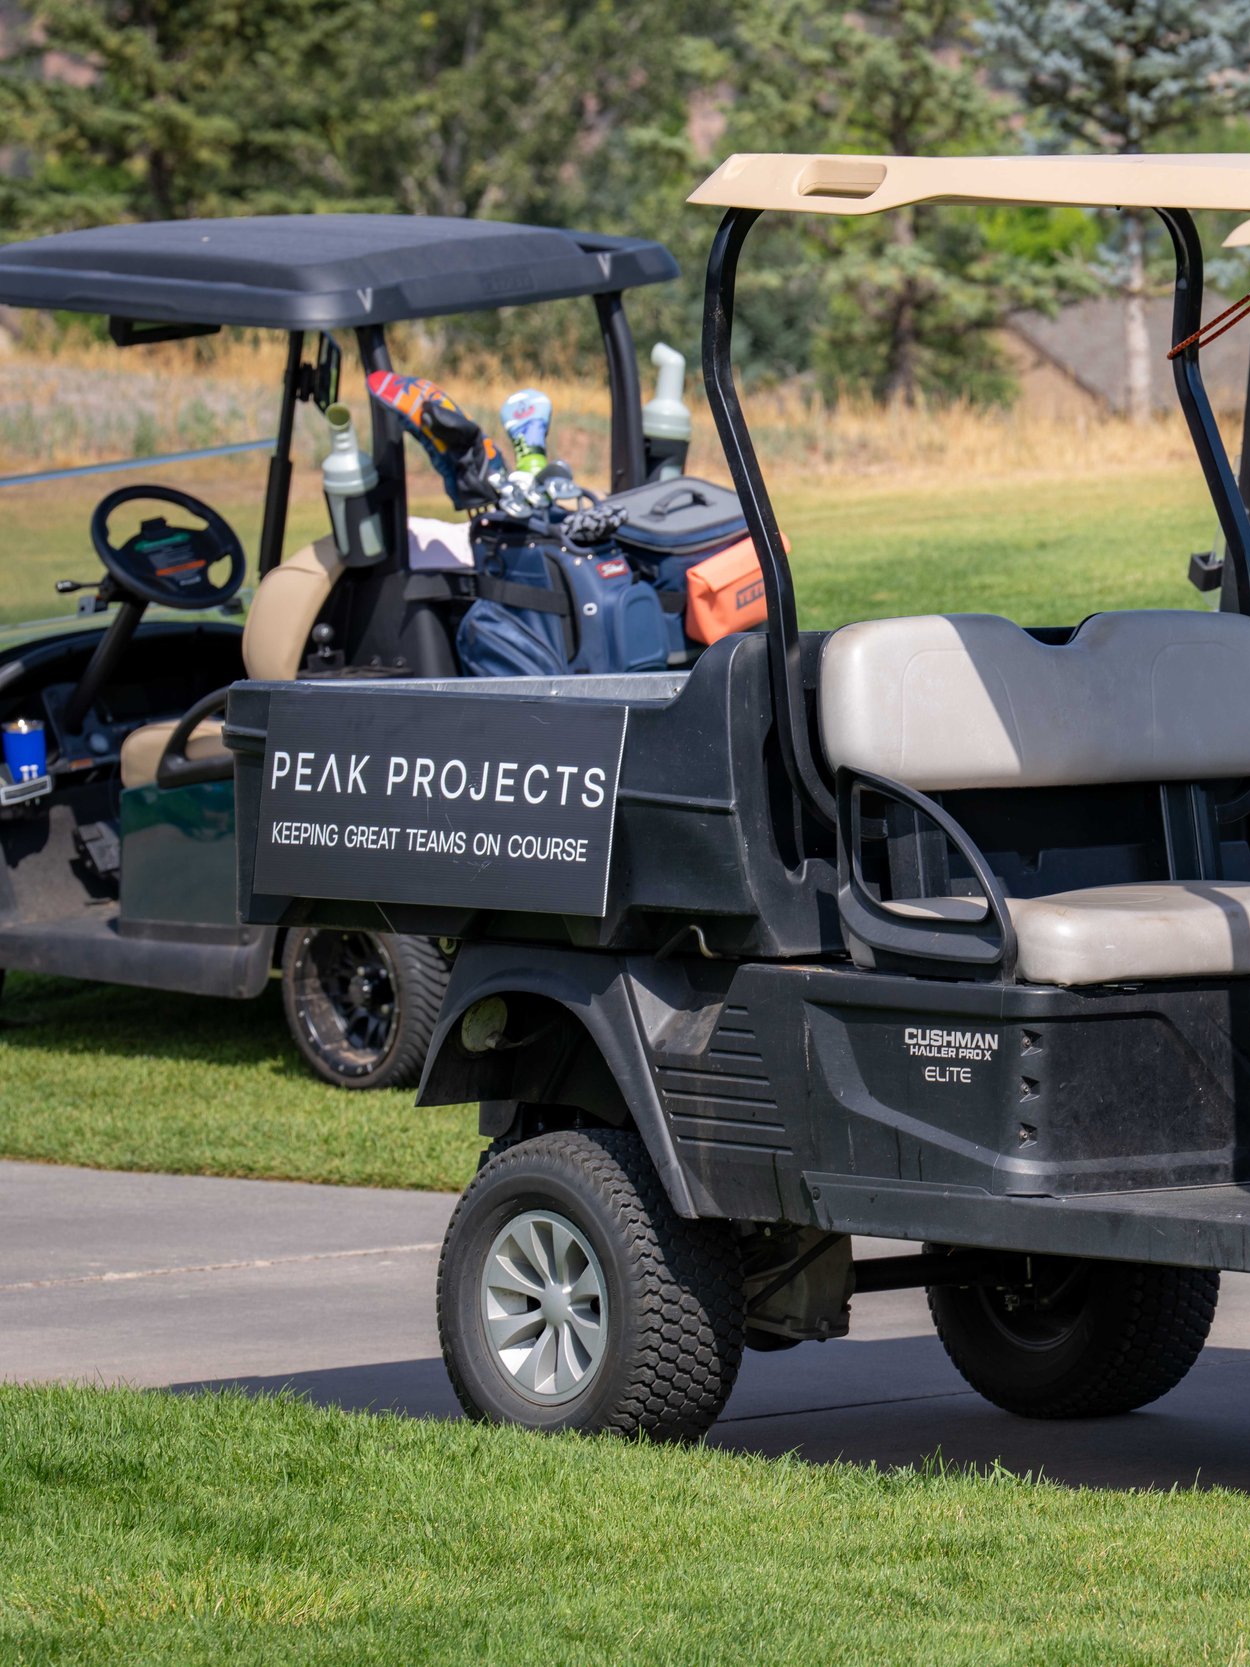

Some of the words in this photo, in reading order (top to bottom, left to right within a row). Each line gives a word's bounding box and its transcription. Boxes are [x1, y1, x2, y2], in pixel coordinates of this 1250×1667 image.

[271, 751, 371, 794] PEAK
[386, 756, 606, 808] PROJECTS
[271, 821, 339, 847] KEEPING
[344, 825, 401, 850] GREAT
[405, 828, 467, 855] TEAMS
[472, 832, 502, 857] ON
[507, 834, 589, 862] COURSE
[904, 1027, 999, 1050] CUSHMAN
[909, 1045, 957, 1058] HAULER
[958, 1048, 982, 1060] PRO
[983, 1050, 992, 1061] X
